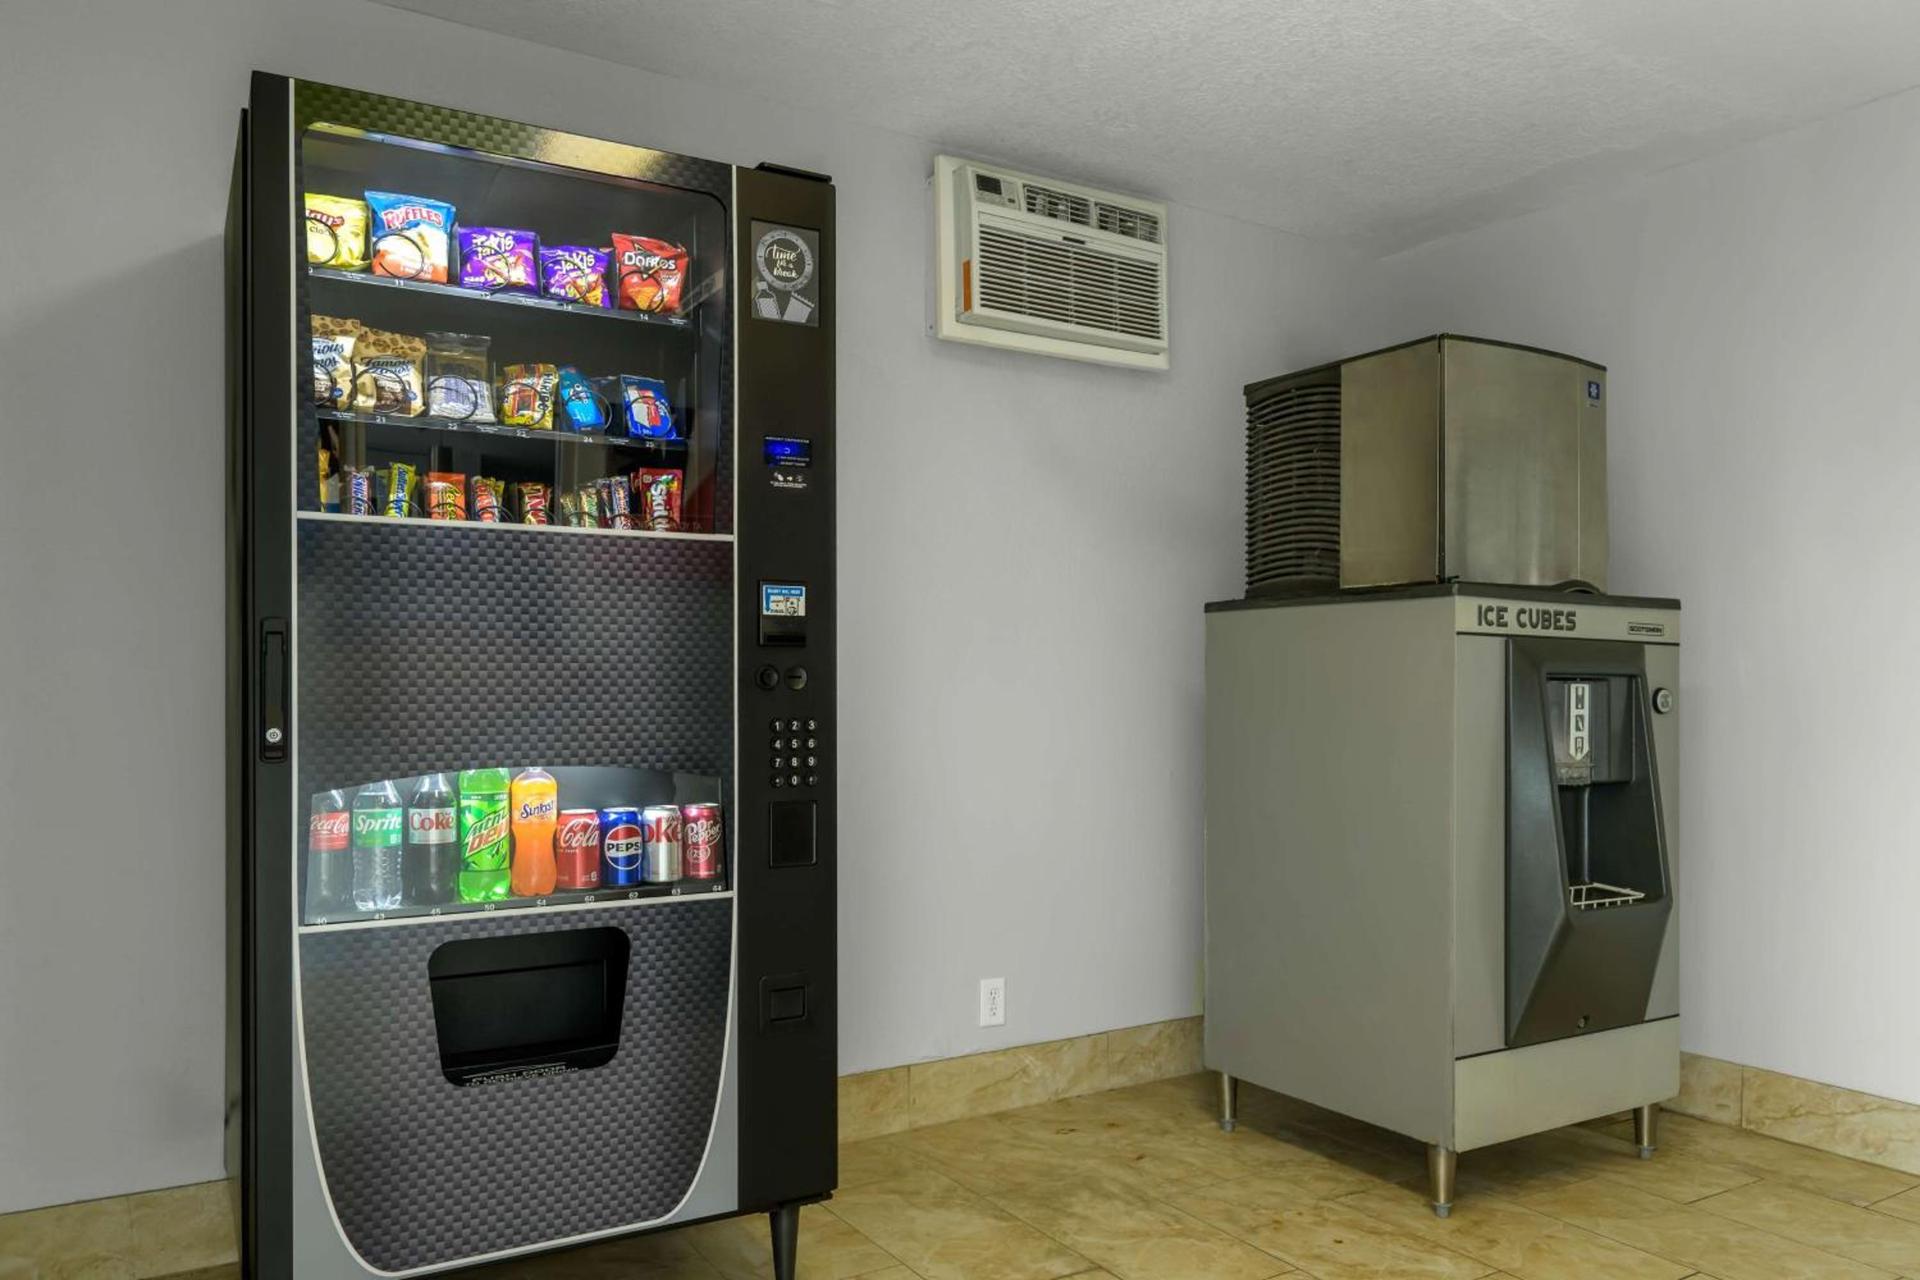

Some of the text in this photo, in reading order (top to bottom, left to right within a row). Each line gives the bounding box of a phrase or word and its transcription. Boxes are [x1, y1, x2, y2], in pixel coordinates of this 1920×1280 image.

[382, 206, 444, 231] RUFFLES
[1477, 604, 1577, 631] ICE CUBES
[774, 720, 815, 731] 1 2 3
[774, 738, 815, 749] 4 5 6
[775, 757, 815, 767] 7 8 9
[791, 775, 798, 785] 0
[410, 812, 454, 831] Coke
[560, 818, 599, 848] Cola
[607, 841, 640, 852] PEPS
